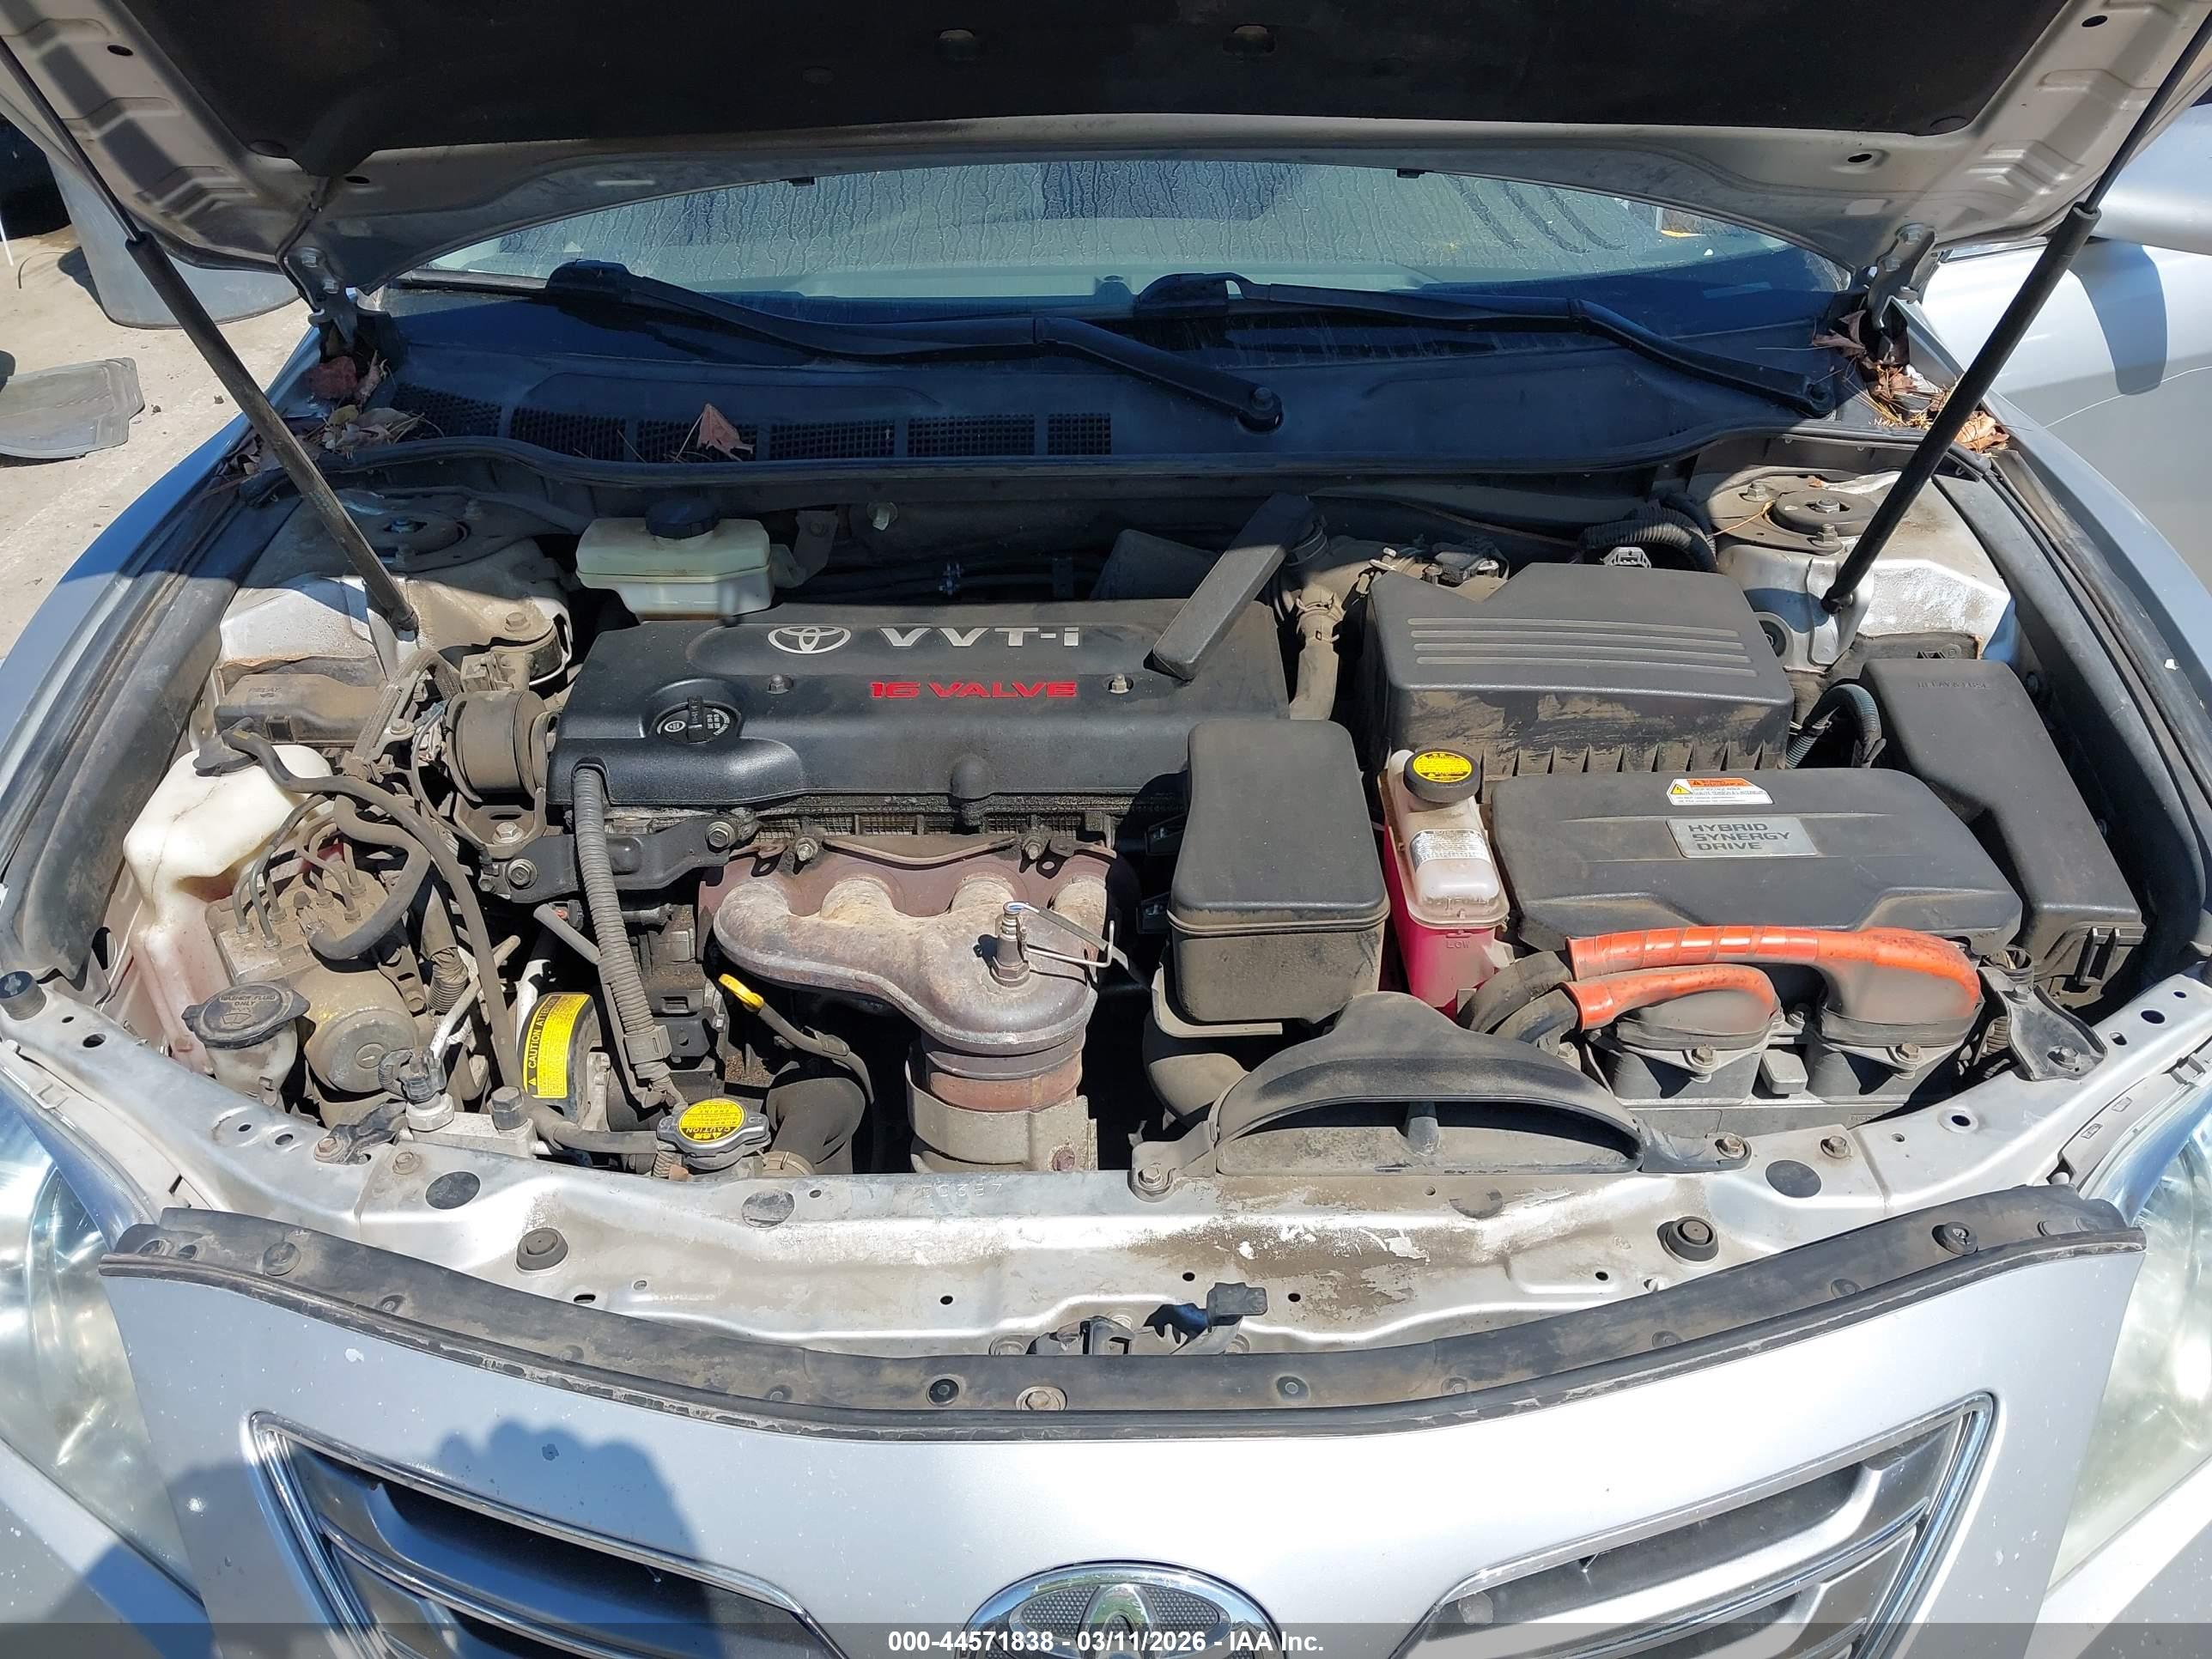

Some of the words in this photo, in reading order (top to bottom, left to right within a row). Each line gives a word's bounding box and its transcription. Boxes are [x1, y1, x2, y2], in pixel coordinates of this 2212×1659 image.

[880, 628, 1079, 647] VVT-i
[871, 682, 921, 698] 16
[927, 681, 1078, 698] VALVE
[1688, 823, 1768, 833] HYBRID
[1692, 832, 1790, 842] SYNERGY
[1697, 842, 1763, 851] DRIVE
[527, 1029, 540, 1069] CAUTION
